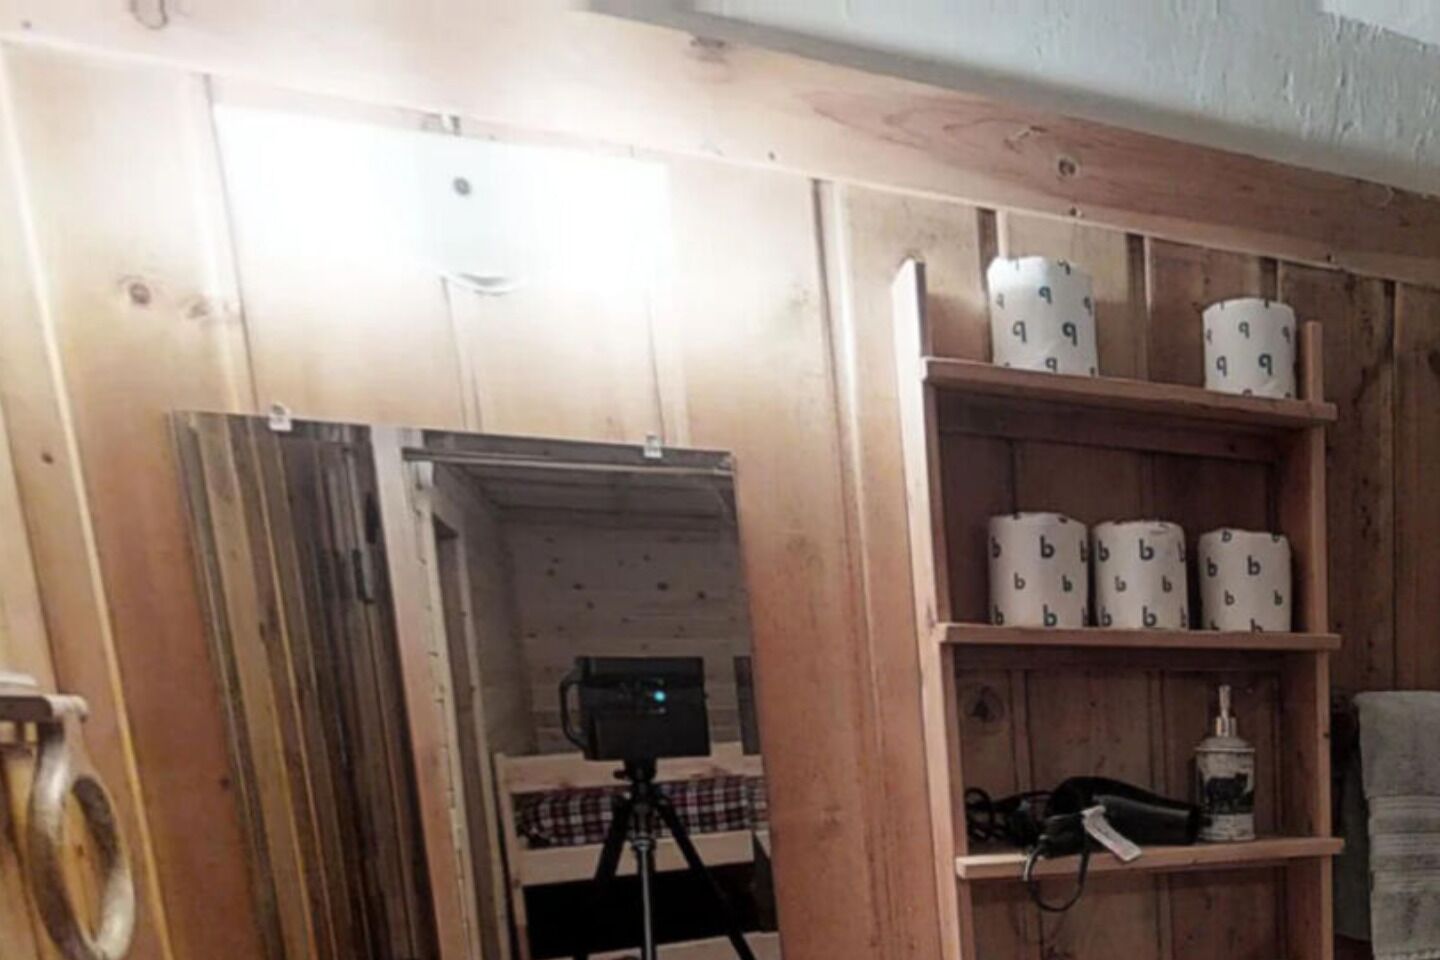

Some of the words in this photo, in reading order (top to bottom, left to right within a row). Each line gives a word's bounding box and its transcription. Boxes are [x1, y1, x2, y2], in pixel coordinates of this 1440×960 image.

[1039, 534, 1055, 559] b
[1098, 540, 1110, 562] b
[1139, 538, 1155, 560] b
[1206, 556, 1219, 577] b
[1247, 554, 1261, 576] b
[1013, 571, 1026, 590] b
[1061, 573, 1073, 593] b
[1114, 575, 1127, 593] b
[1161, 574, 1173, 593] b
[1224, 589, 1235, 606] b
[1273, 589, 1283, 606] b
[1043, 603, 1058, 627] b
[1101, 605, 1113, 627] b
[1142, 605, 1158, 628] b
